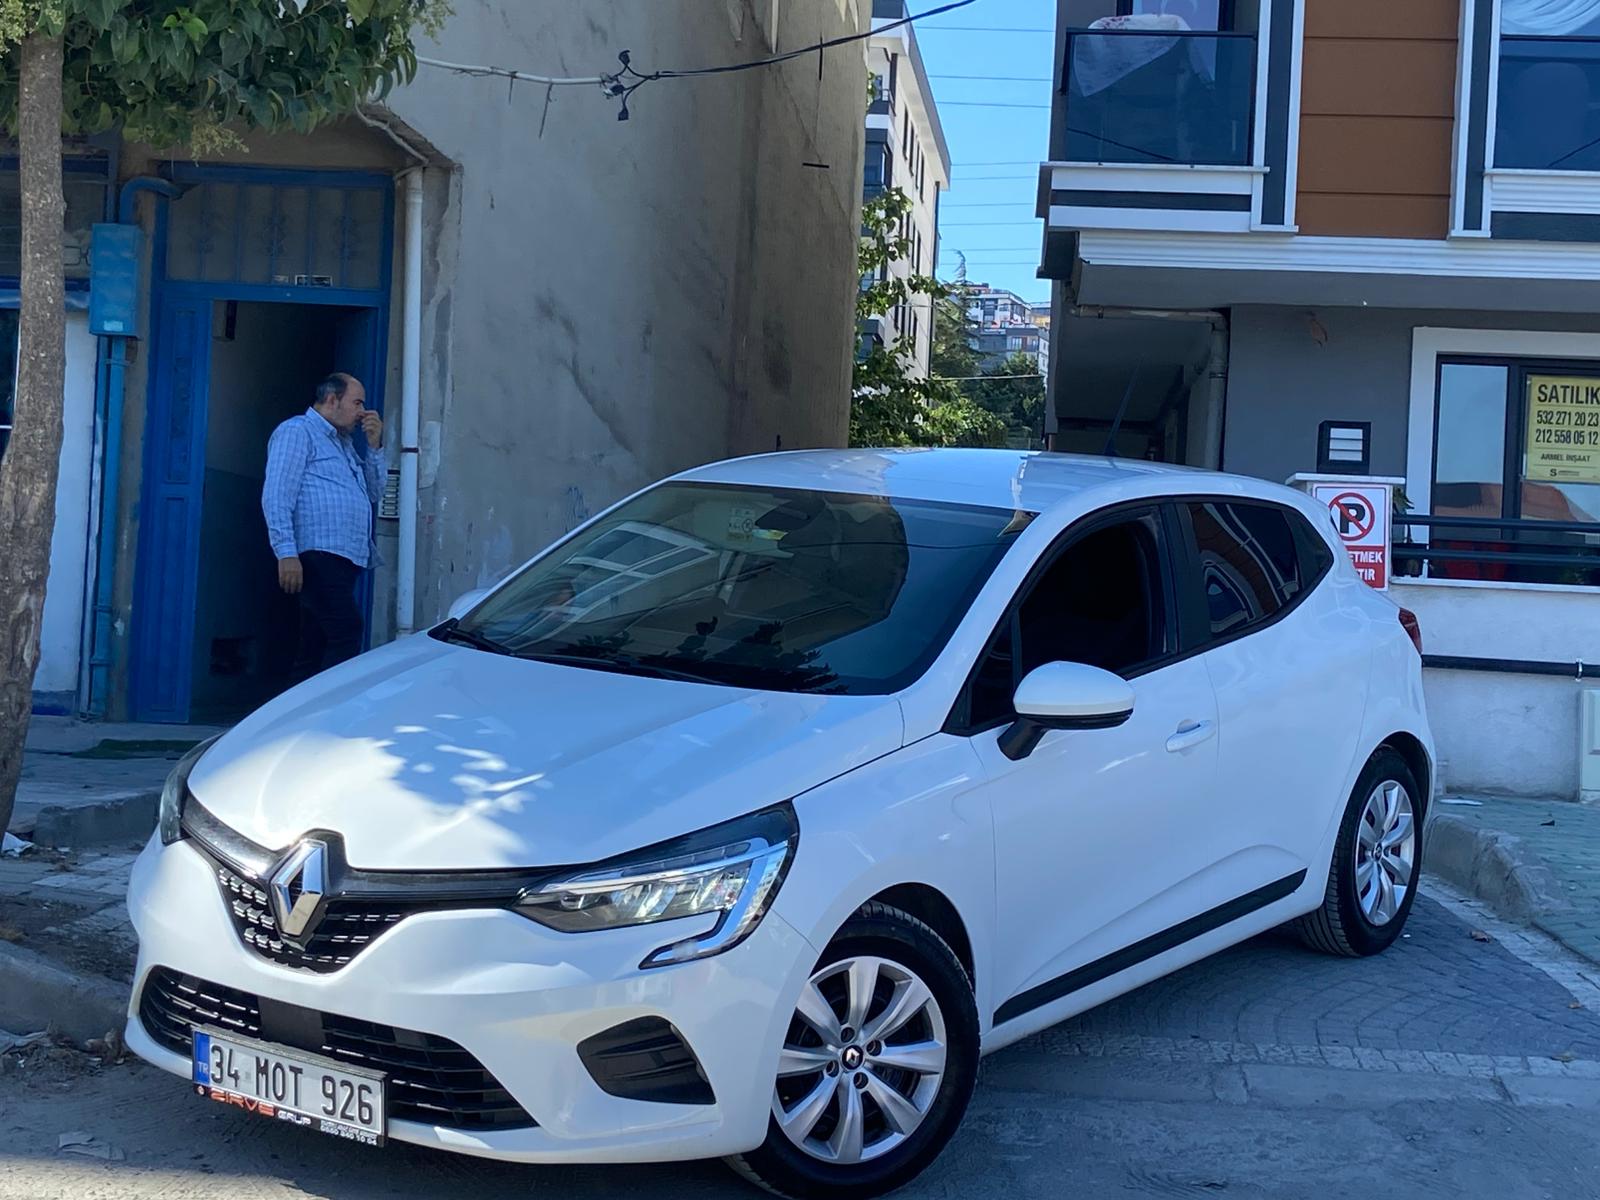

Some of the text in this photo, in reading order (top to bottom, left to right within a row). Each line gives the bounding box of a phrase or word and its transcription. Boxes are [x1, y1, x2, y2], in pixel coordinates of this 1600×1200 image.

[1537, 384, 1600, 405] SATILIK
[1537, 410, 1600, 427] 532 271 20 23
[1535, 429, 1599, 445] 212 558 05 12
[1356, 568, 1376, 581] TIR
[198, 1061, 209, 1075] TR
[211, 1044, 373, 1125] 34 MOT 926
